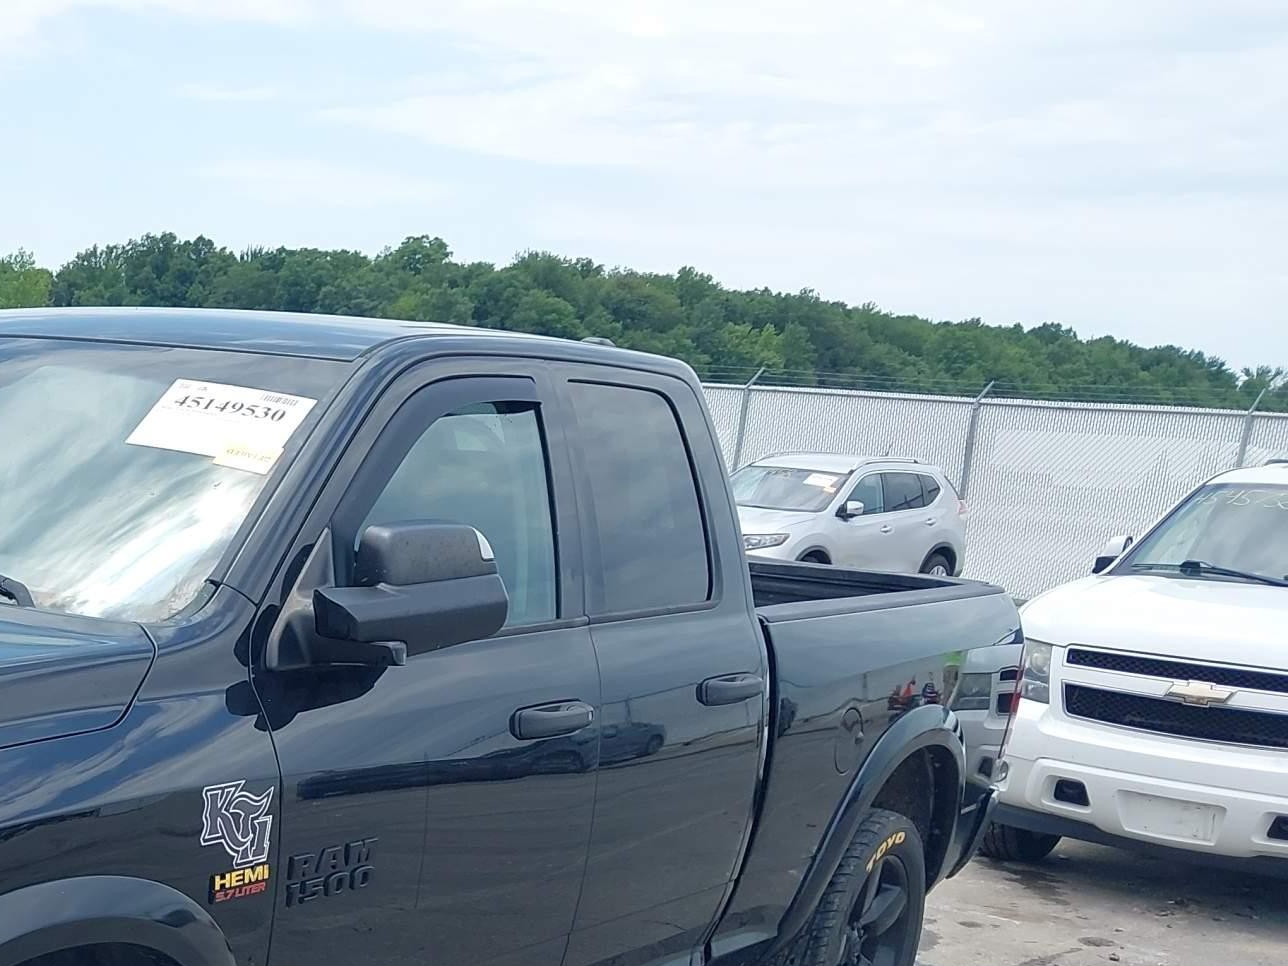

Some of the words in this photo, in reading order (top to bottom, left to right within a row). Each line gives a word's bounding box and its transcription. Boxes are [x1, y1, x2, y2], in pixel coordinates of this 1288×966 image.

[174, 394, 286, 421] 45149530
[287, 837, 379, 881] RAM
[865, 831, 906, 873] TOYO
[215, 864, 269, 891] HEMI
[286, 864, 376, 908] 1500
